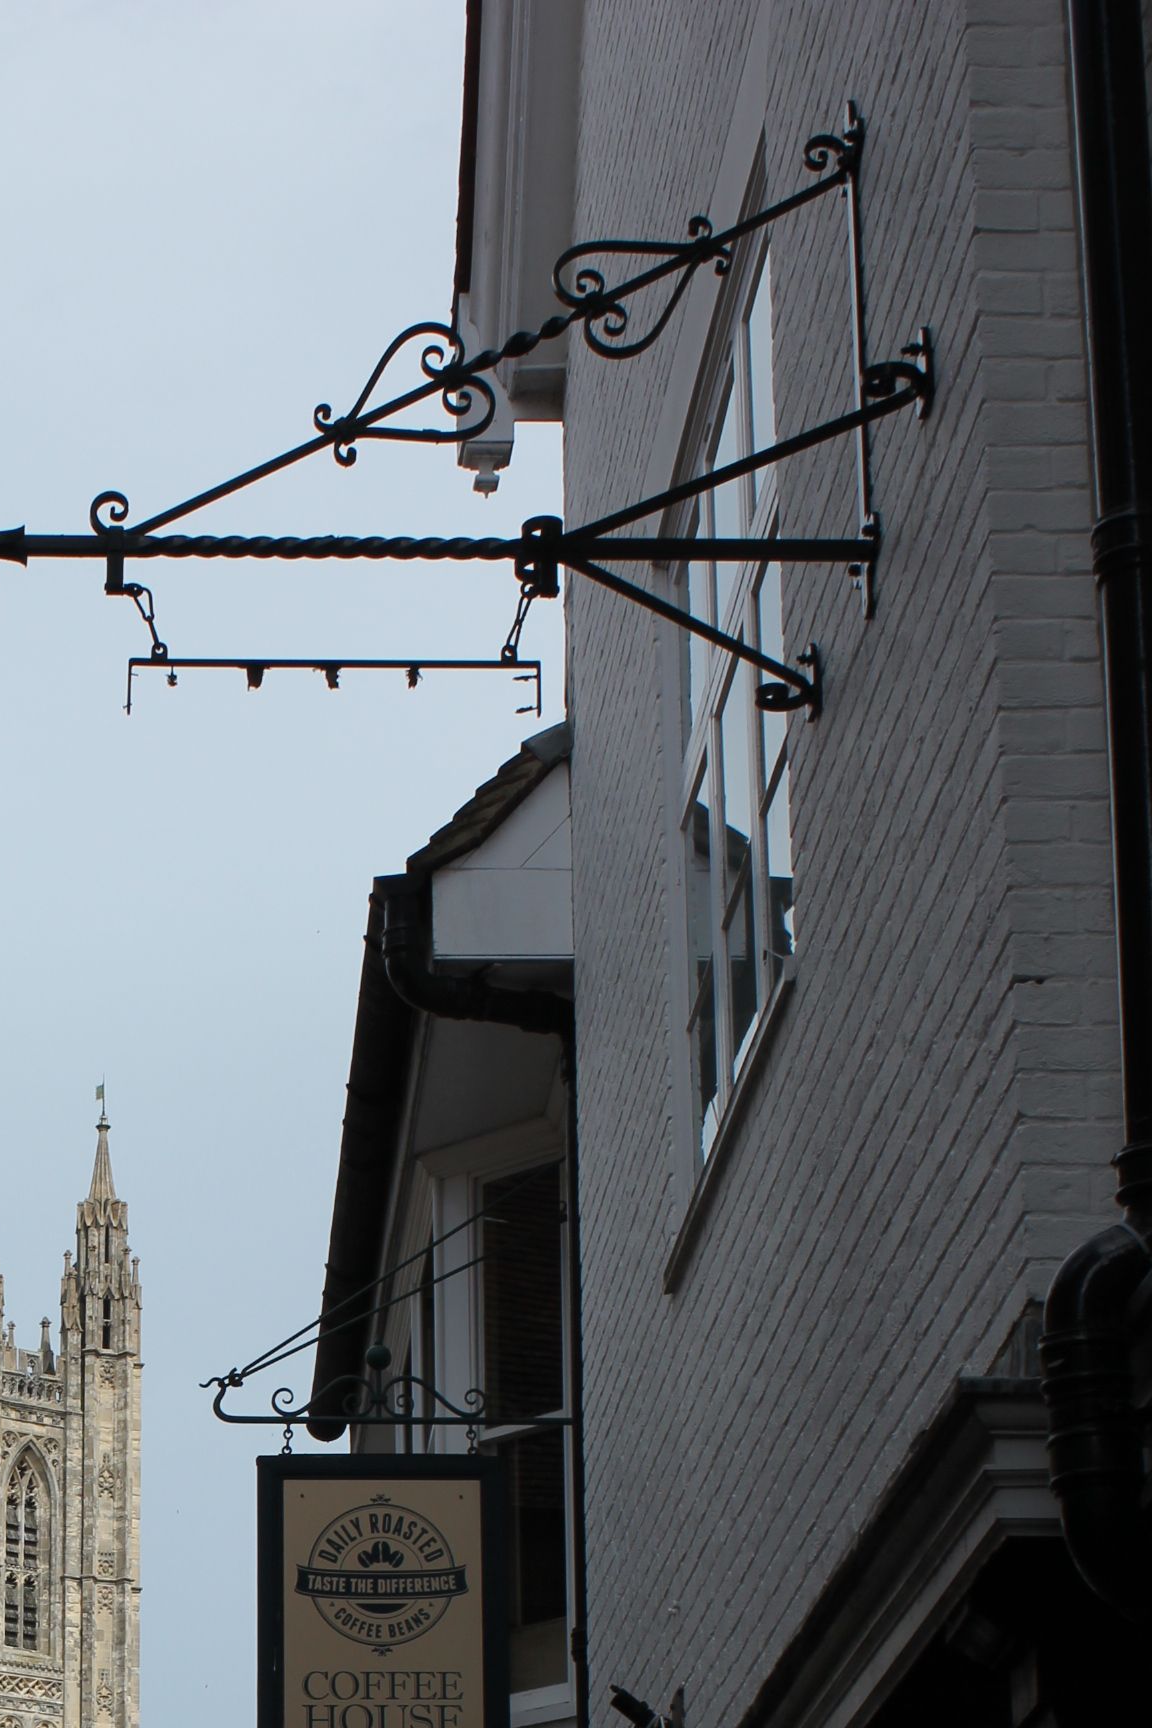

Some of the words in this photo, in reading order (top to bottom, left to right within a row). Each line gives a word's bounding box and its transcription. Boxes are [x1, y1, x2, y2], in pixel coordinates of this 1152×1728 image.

[318, 1517, 363, 1564] DAILY
[369, 1513, 445, 1563] ROASTED
[308, 1575, 346, 1592] TASTE
[350, 1577, 375, 1593] THE
[377, 1575, 457, 1593] DIFFERENCE
[334, 1607, 382, 1639] COFFEE
[388, 1607, 431, 1638] BEANS
[302, 1671, 464, 1700] COFFEE
